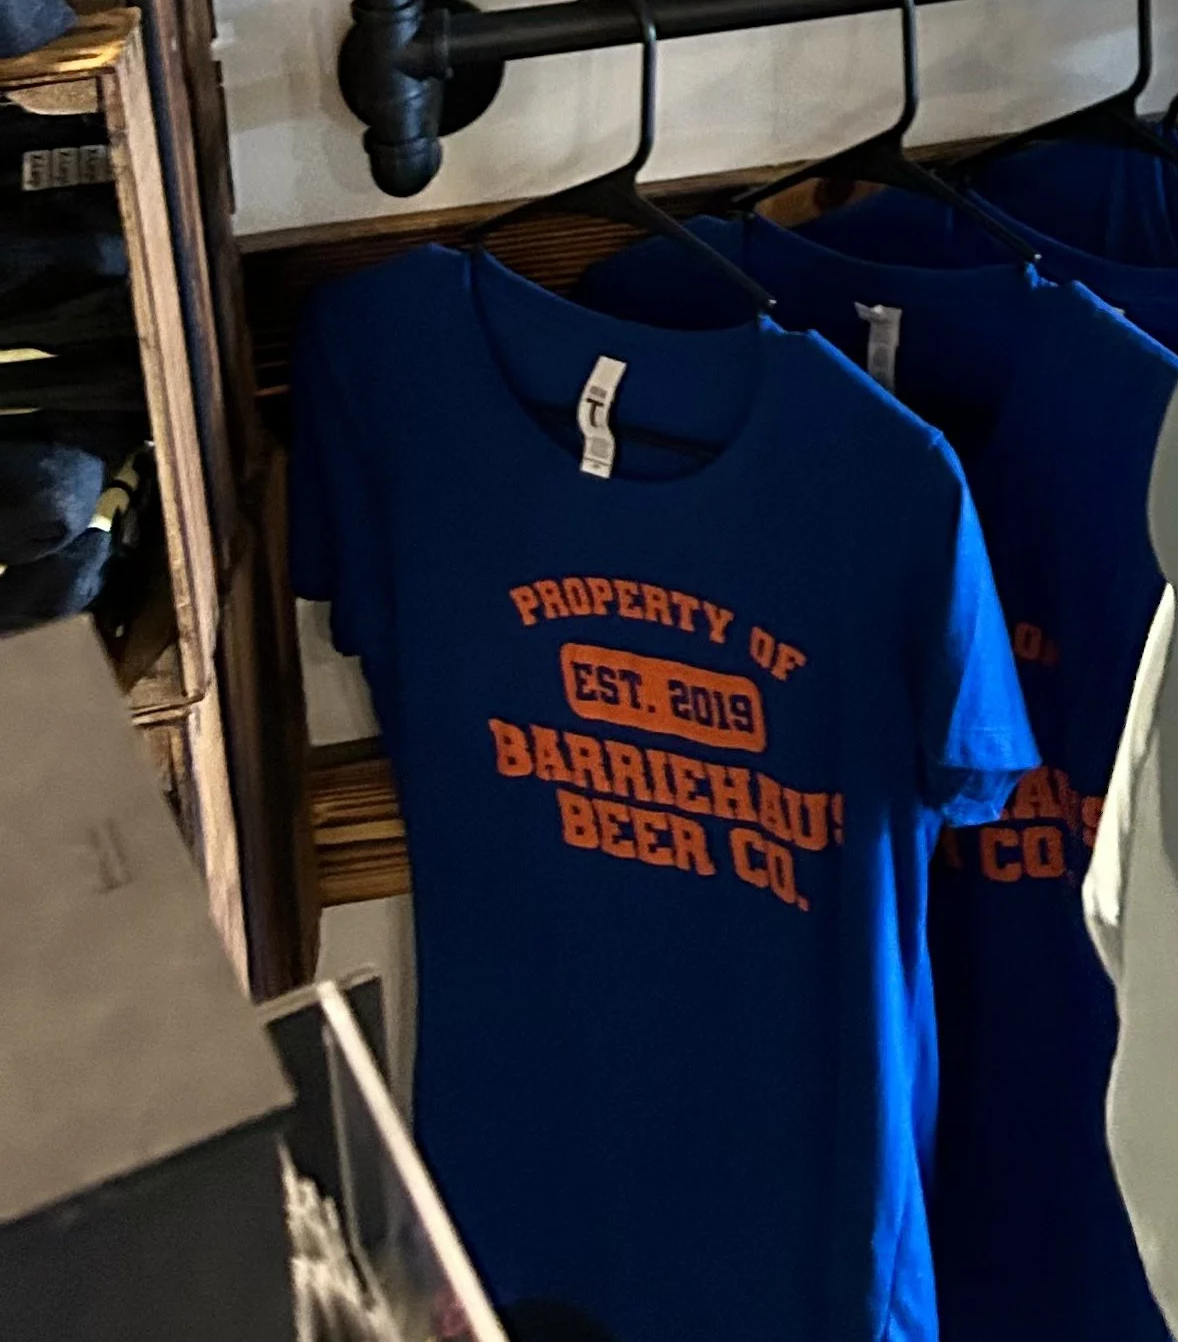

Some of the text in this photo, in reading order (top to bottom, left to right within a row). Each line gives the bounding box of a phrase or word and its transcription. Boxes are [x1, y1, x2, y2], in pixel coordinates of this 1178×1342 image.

[509, 576, 807, 681] PROPERTY OF
[571, 661, 754, 734] EST. 2019
[557, 788, 810, 912] BEER CO.
